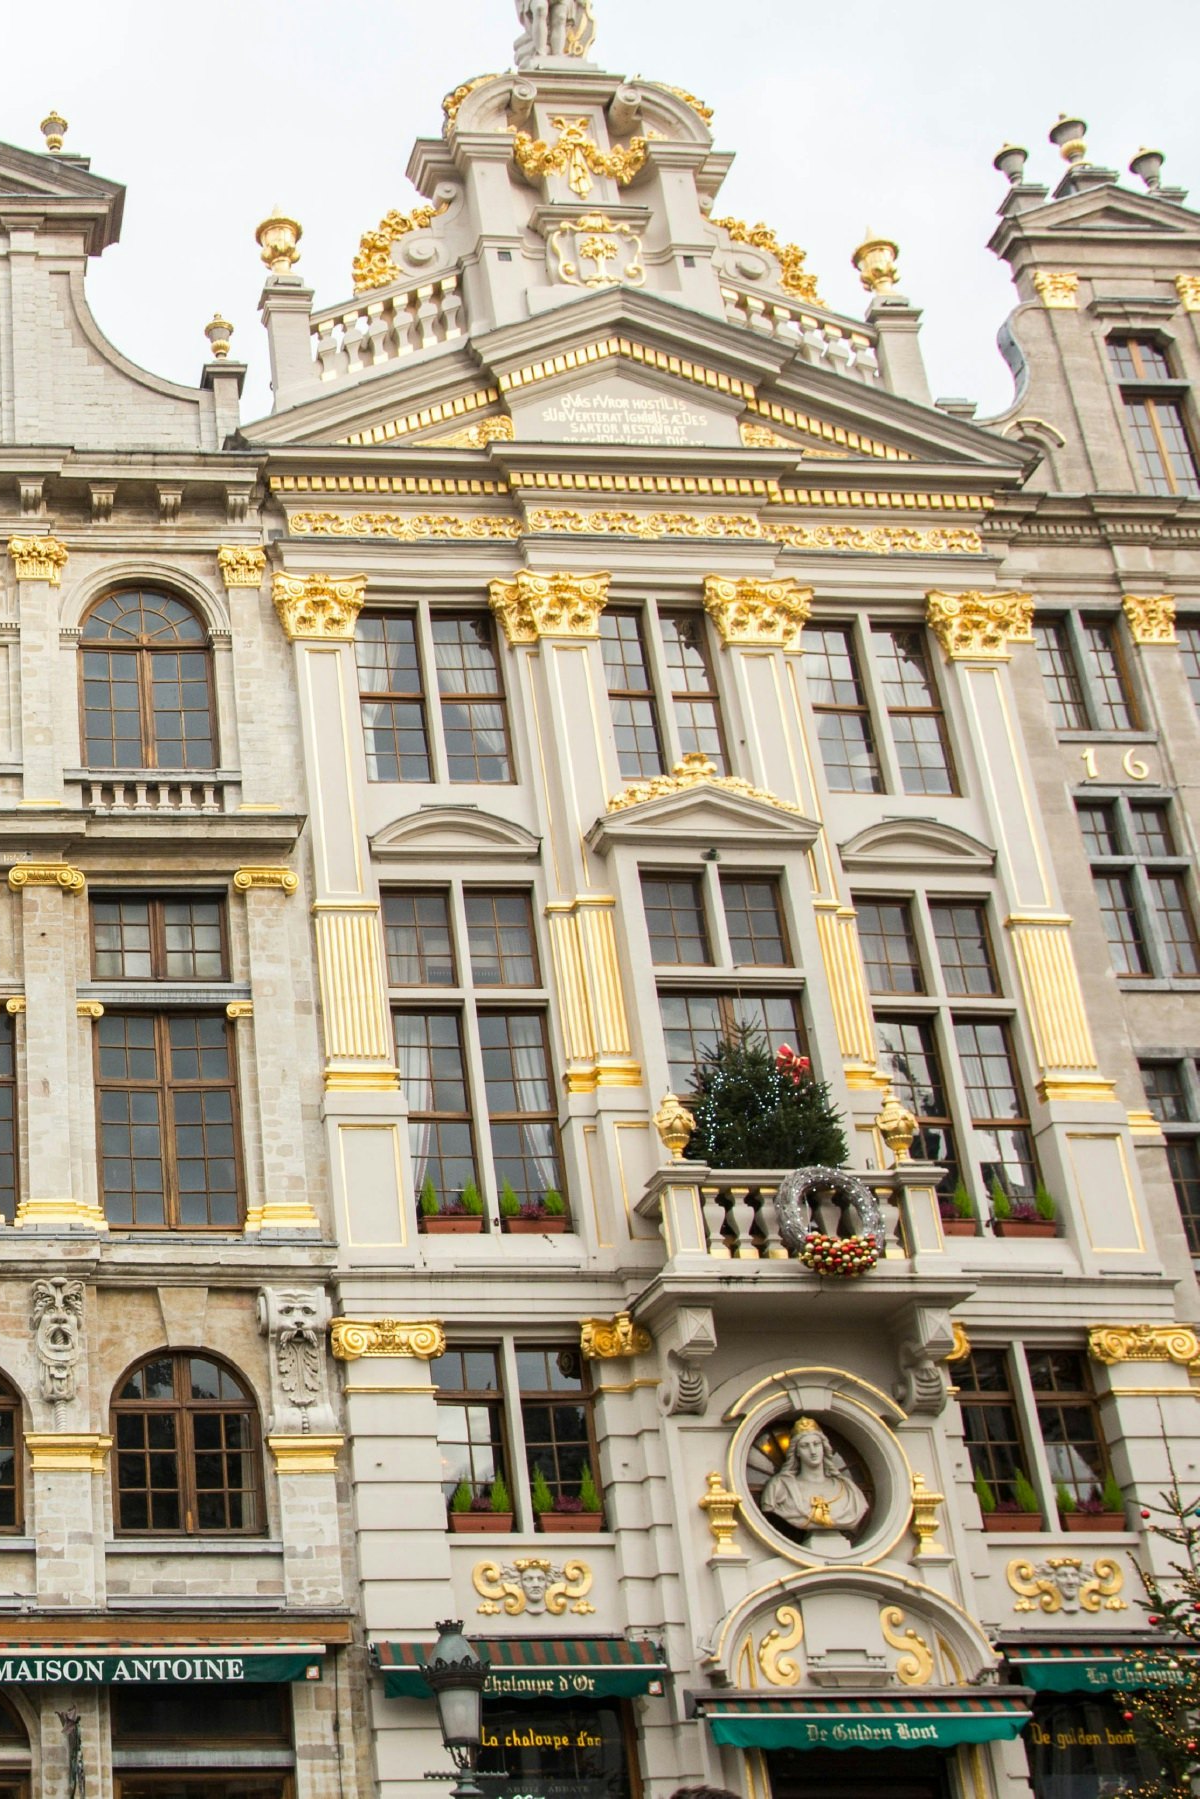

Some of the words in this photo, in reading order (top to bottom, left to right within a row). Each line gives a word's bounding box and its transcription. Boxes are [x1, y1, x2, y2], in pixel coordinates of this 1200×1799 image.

[592, 395, 629, 409] FVROR
[632, 397, 687, 411] HOSTILIS
[570, 422, 619, 434] SARTOR
[111, 1659, 244, 1681] ANTOINE
[1086, 1667, 1109, 1684] La
[483, 1674, 555, 1695] Chaloupe
[559, 1674, 596, 1693] d'Or
[481, 1725, 498, 1747] La
[505, 1727, 570, 1750] chaloupe
[805, 1723, 828, 1741] De
[832, 1723, 892, 1741] Gulden
[894, 1722, 939, 1740] Boot
[1031, 1722, 1050, 1745] De
[1056, 1727, 1102, 1749] gulden
